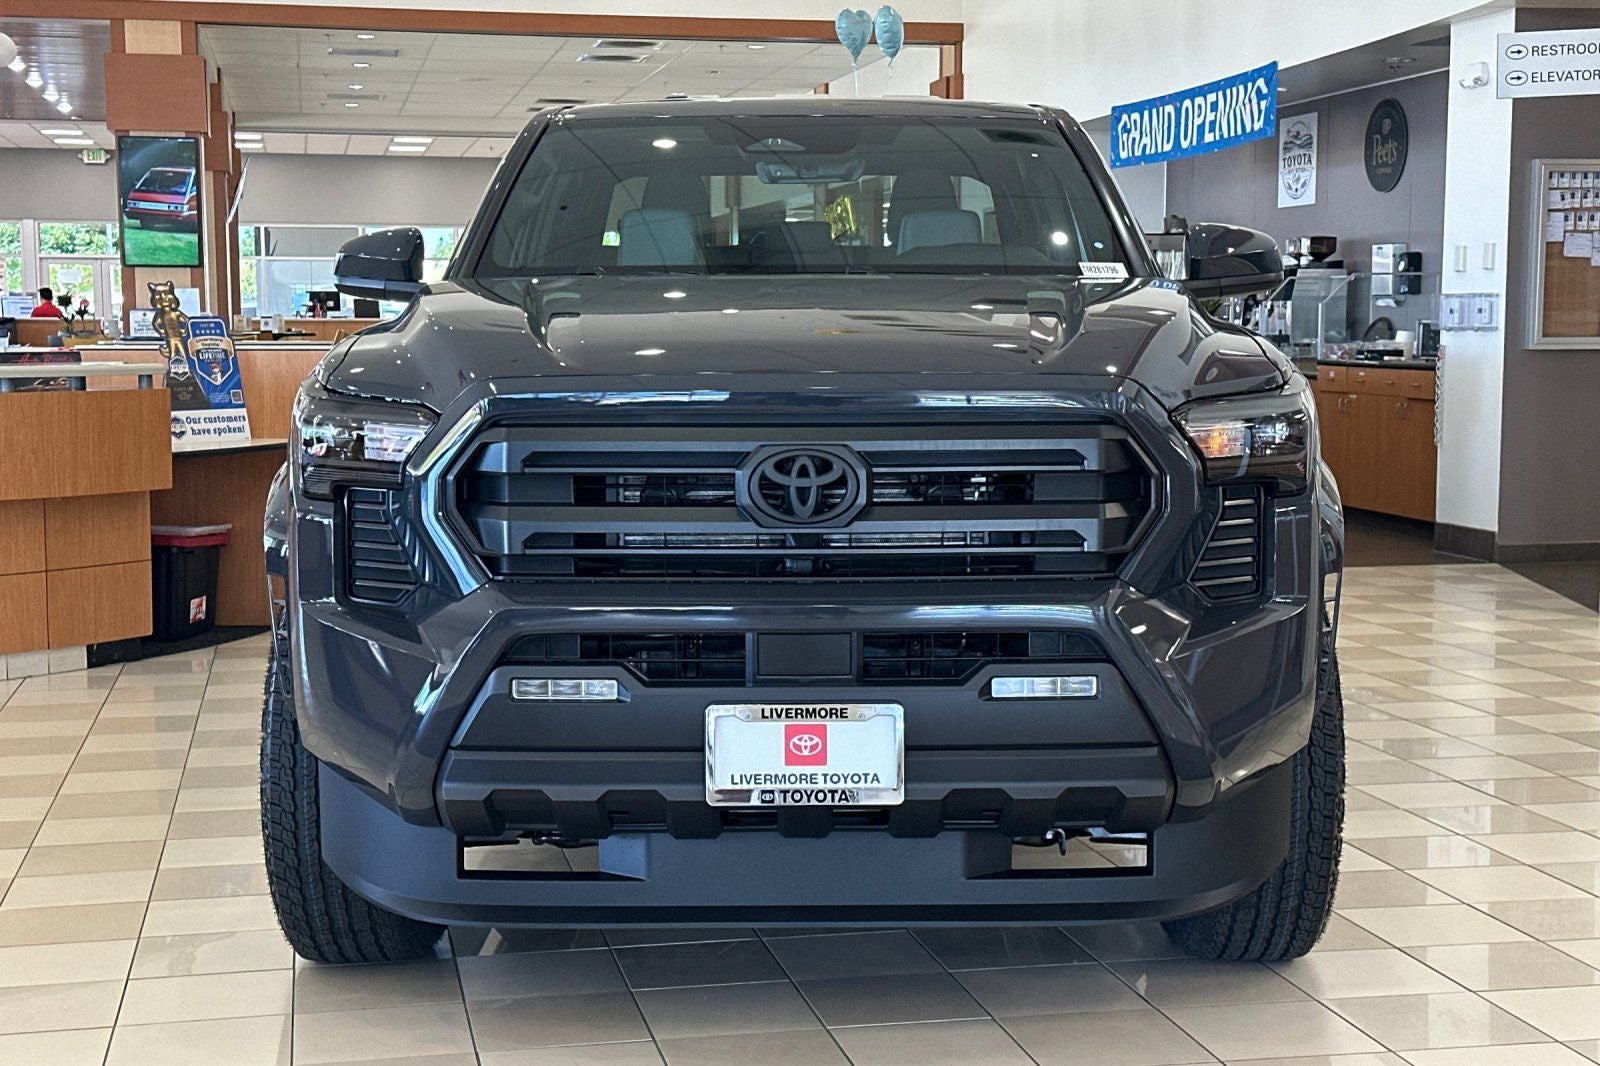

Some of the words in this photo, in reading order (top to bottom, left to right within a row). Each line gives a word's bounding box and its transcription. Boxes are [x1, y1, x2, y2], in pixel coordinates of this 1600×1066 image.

[1531, 43, 1600, 56] RESTROO
[1531, 69, 1600, 83] ELEVATOR
[1118, 104, 1175, 159] GRAND
[1180, 77, 1268, 149] OPENING
[1282, 153, 1312, 169] TOYOTA
[199, 351, 226, 360] LIFETIME
[185, 416, 201, 425] Our
[203, 414, 247, 424] customers
[190, 426, 211, 436] have
[213, 425, 245, 436] spoken!
[761, 707, 849, 719] LIVERMORE
[730, 773, 818, 785] LIVERMORE
[821, 773, 880, 785] TOYOTA
[779, 790, 850, 803] TOYOTA
